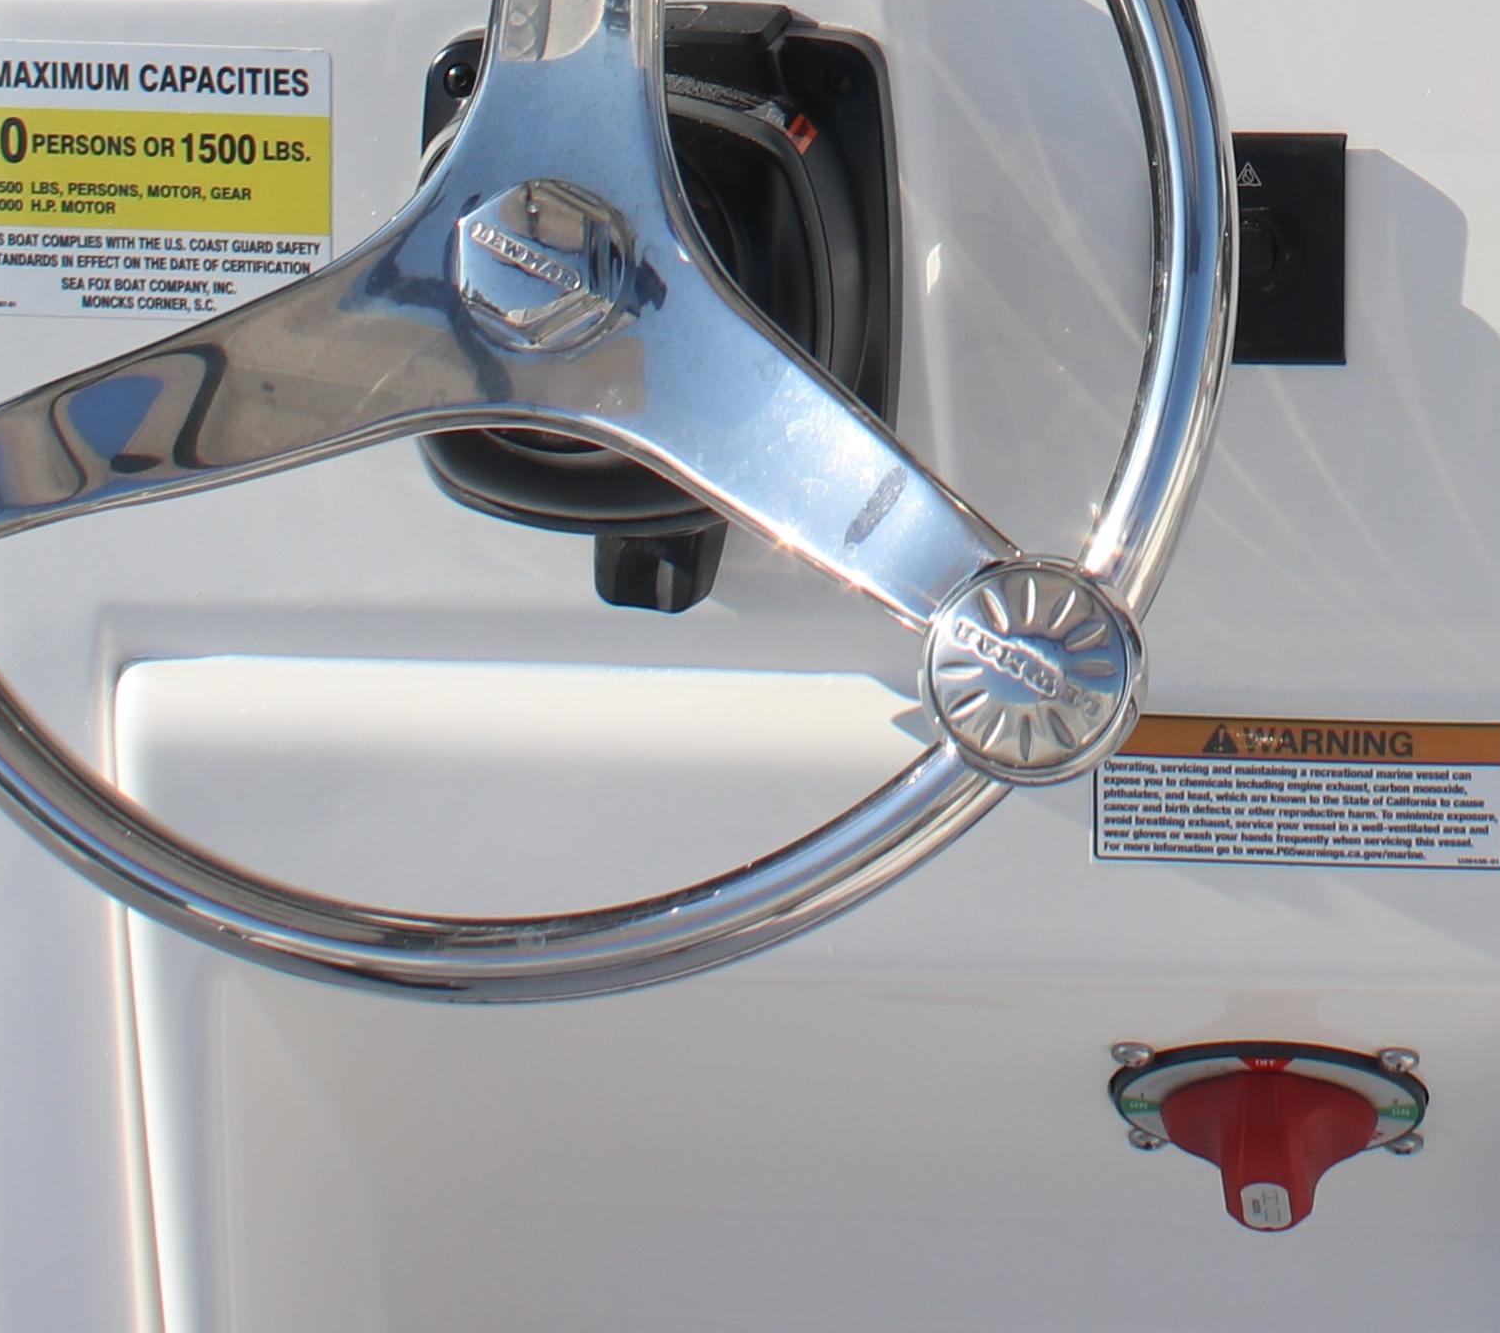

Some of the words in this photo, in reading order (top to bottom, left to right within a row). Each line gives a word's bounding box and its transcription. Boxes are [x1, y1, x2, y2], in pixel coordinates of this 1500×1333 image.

[138, 63, 308, 97] CAPACITIES
[32, 135, 136, 156] PERSONS
[144, 136, 176, 156] OR
[181, 133, 256, 164] 1500
[263, 141, 311, 162] LBS.
[30, 181, 63, 196] LBS,
[67, 182, 143, 197] PERSONS,
[146, 184, 206, 200] MOTOR,
[209, 186, 251, 200] GEAR
[30, 199, 56, 212] H.P.
[60, 199, 115, 214] MOTOR
[7, 233, 39, 247] BOAT
[41, 233, 103, 249] COMPLIES
[105, 235, 135, 249] WITH
[137, 236, 161, 250] THE
[164, 237, 186, 251] U.S.
[189, 238, 229, 252] COAST
[231, 239, 273, 254] GUARD
[275, 240, 320, 255] SAFETY
[61, 255, 73, 267] IN
[76, 254, 120, 269] EFFECT
[123, 255, 141, 269] ON
[143, 256, 167, 270] THE
[169, 257, 200, 271] DATE
[202, 258, 219, 272] OF
[221, 259, 312, 274] CERTIFICATION
[61, 276, 85, 290] SEA
[87, 277, 111, 291] FOX
[114, 277, 146, 291] BOAT
[148, 278, 209, 294] COMPANY,
[212, 281, 235, 295] INC.
[81, 295, 134, 309] MONCKS
[137, 296, 191, 311] CORNER,
[193, 298, 216, 311] S.C.
[1243, 726, 1414, 757] WARNING
[1103, 759, 1158, 774] Operating,
[1160, 762, 1209, 776] servicing
[1211, 763, 1232, 775] and
[1234, 764, 1297, 779] maintaining
[1309, 767, 1373, 779] recreational
[1375, 769, 1413, 780] marine
[1415, 769, 1449, 780] vessel
[1451, 771, 1471, 781] can
[1103, 841, 1120, 851] For
[1123, 843, 1150, 852] more
[1152, 842, 1214, 853] information
[1216, 846, 1230, 856] go
[1232, 844, 1243, 855] to
